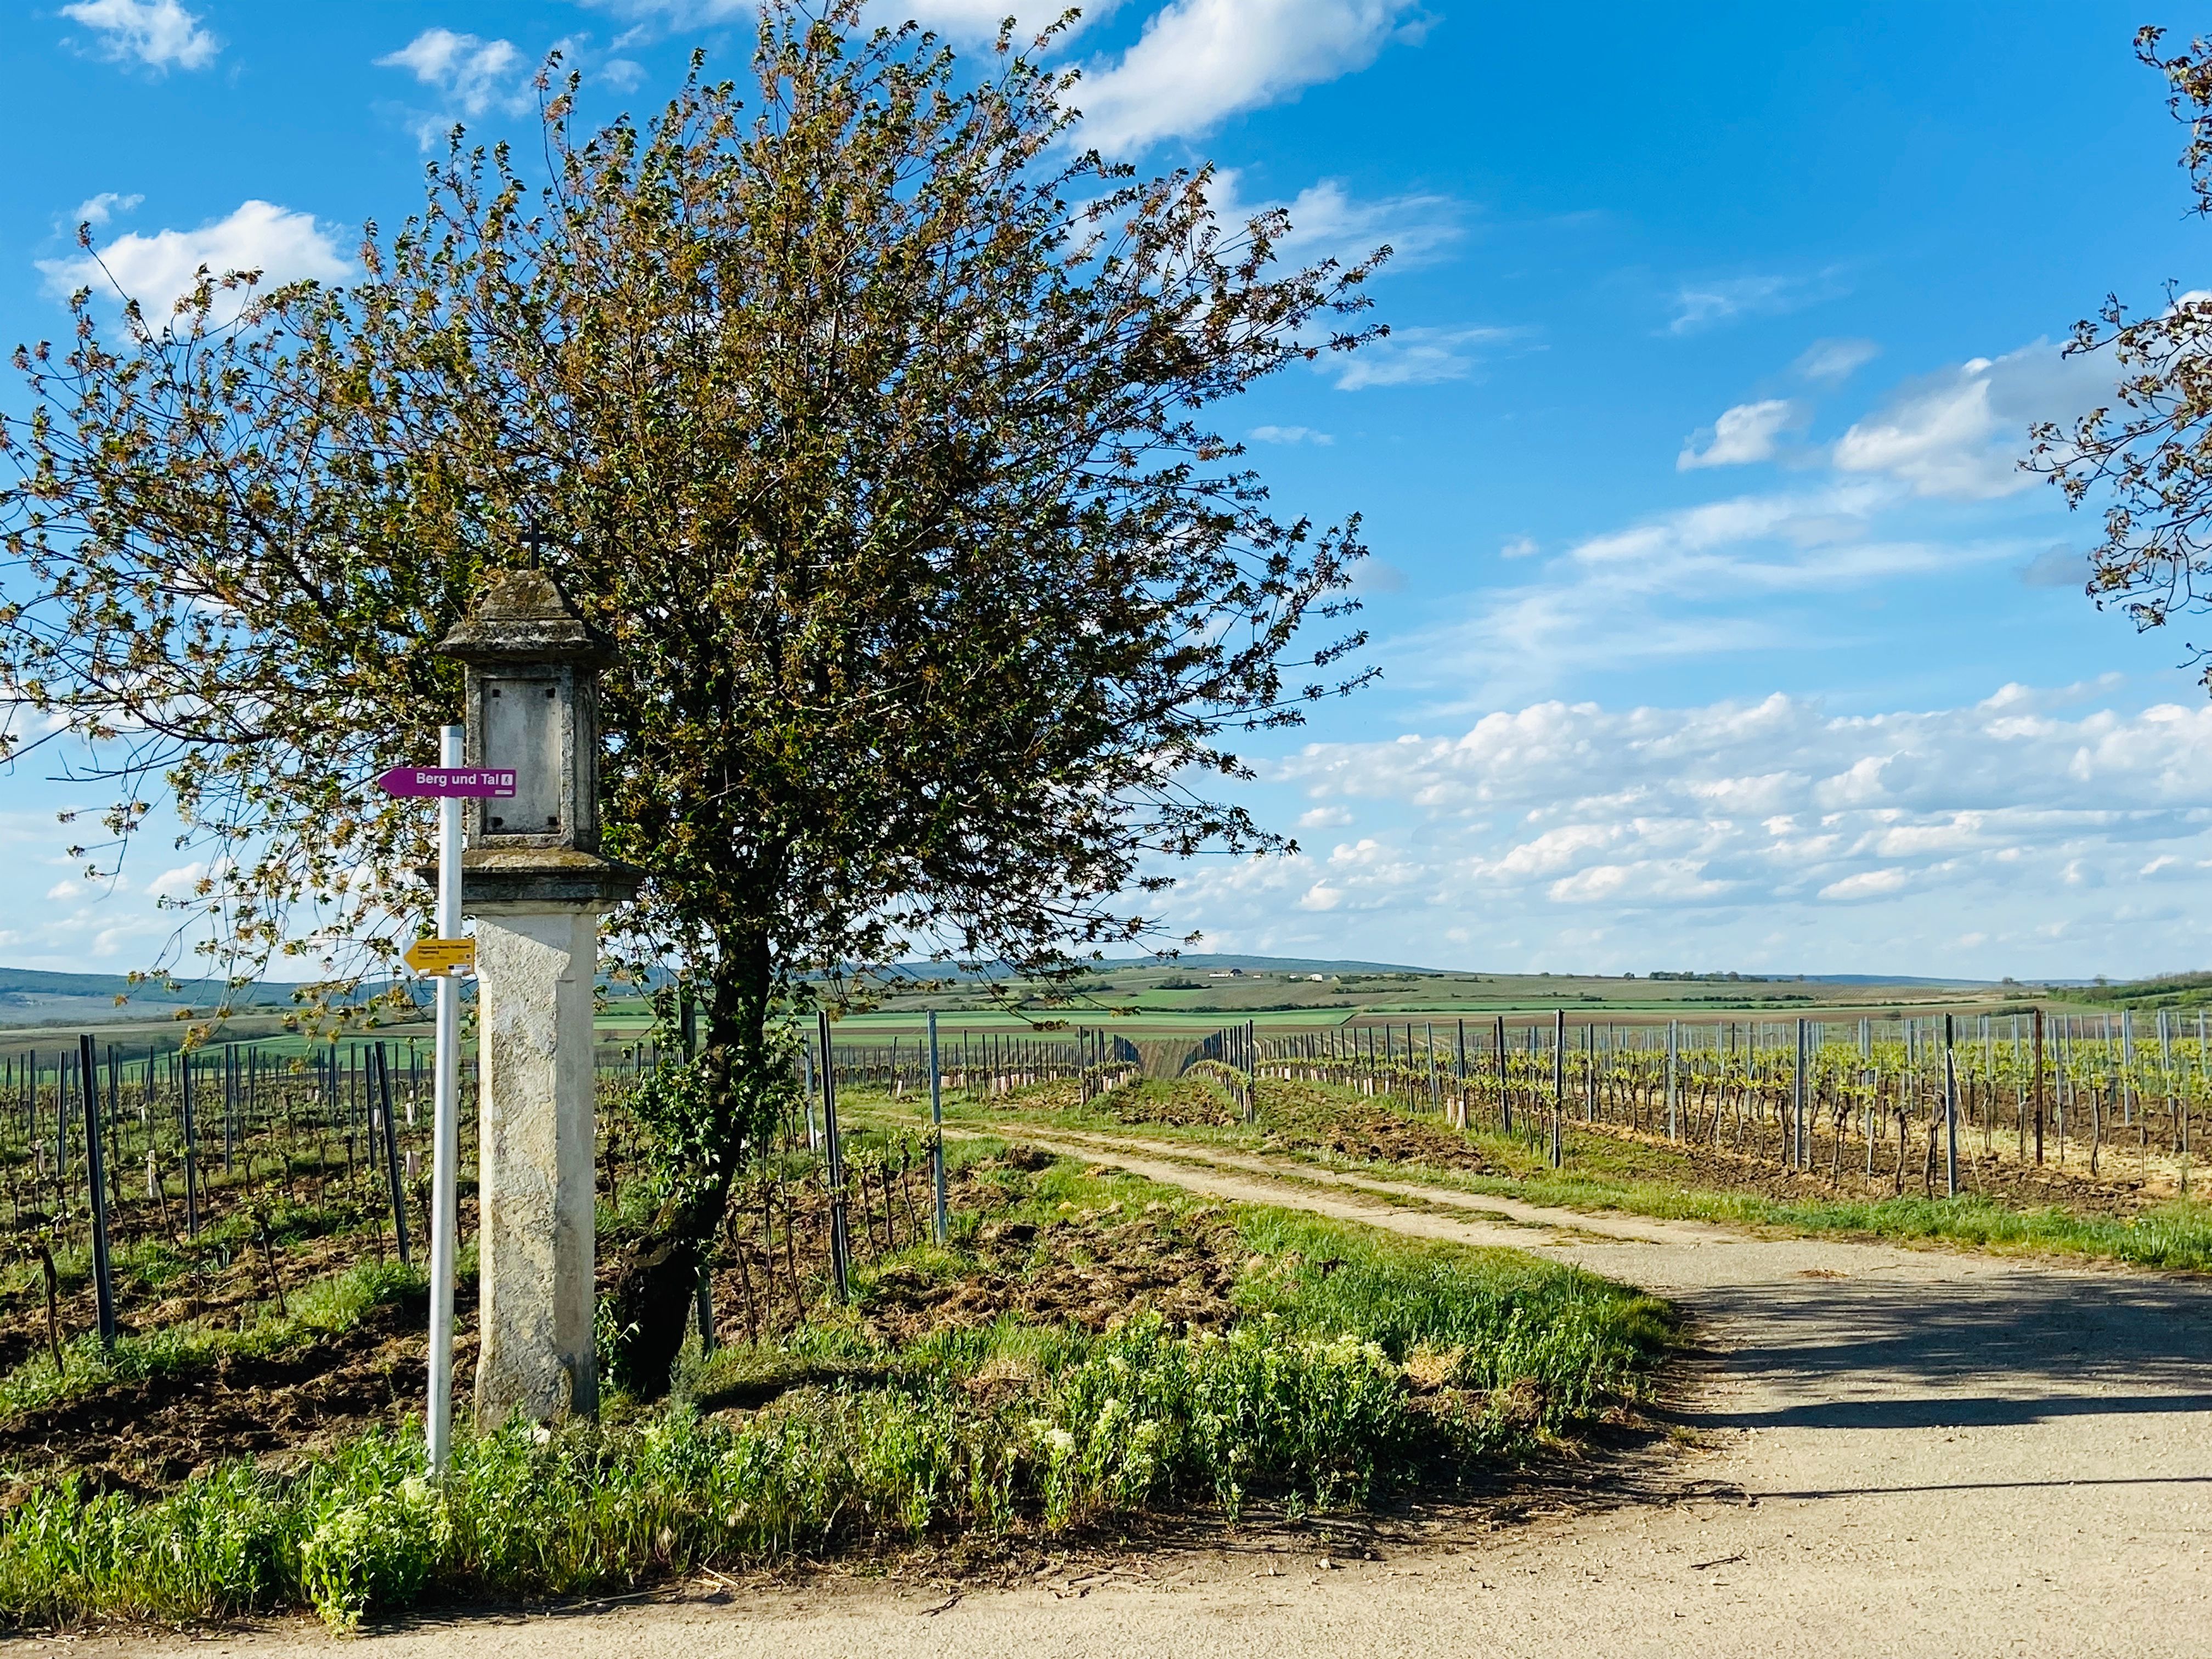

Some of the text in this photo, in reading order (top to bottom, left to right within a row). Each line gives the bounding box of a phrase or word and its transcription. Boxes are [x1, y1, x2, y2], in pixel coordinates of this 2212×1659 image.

[416, 772, 499, 787] Berg und Tal
